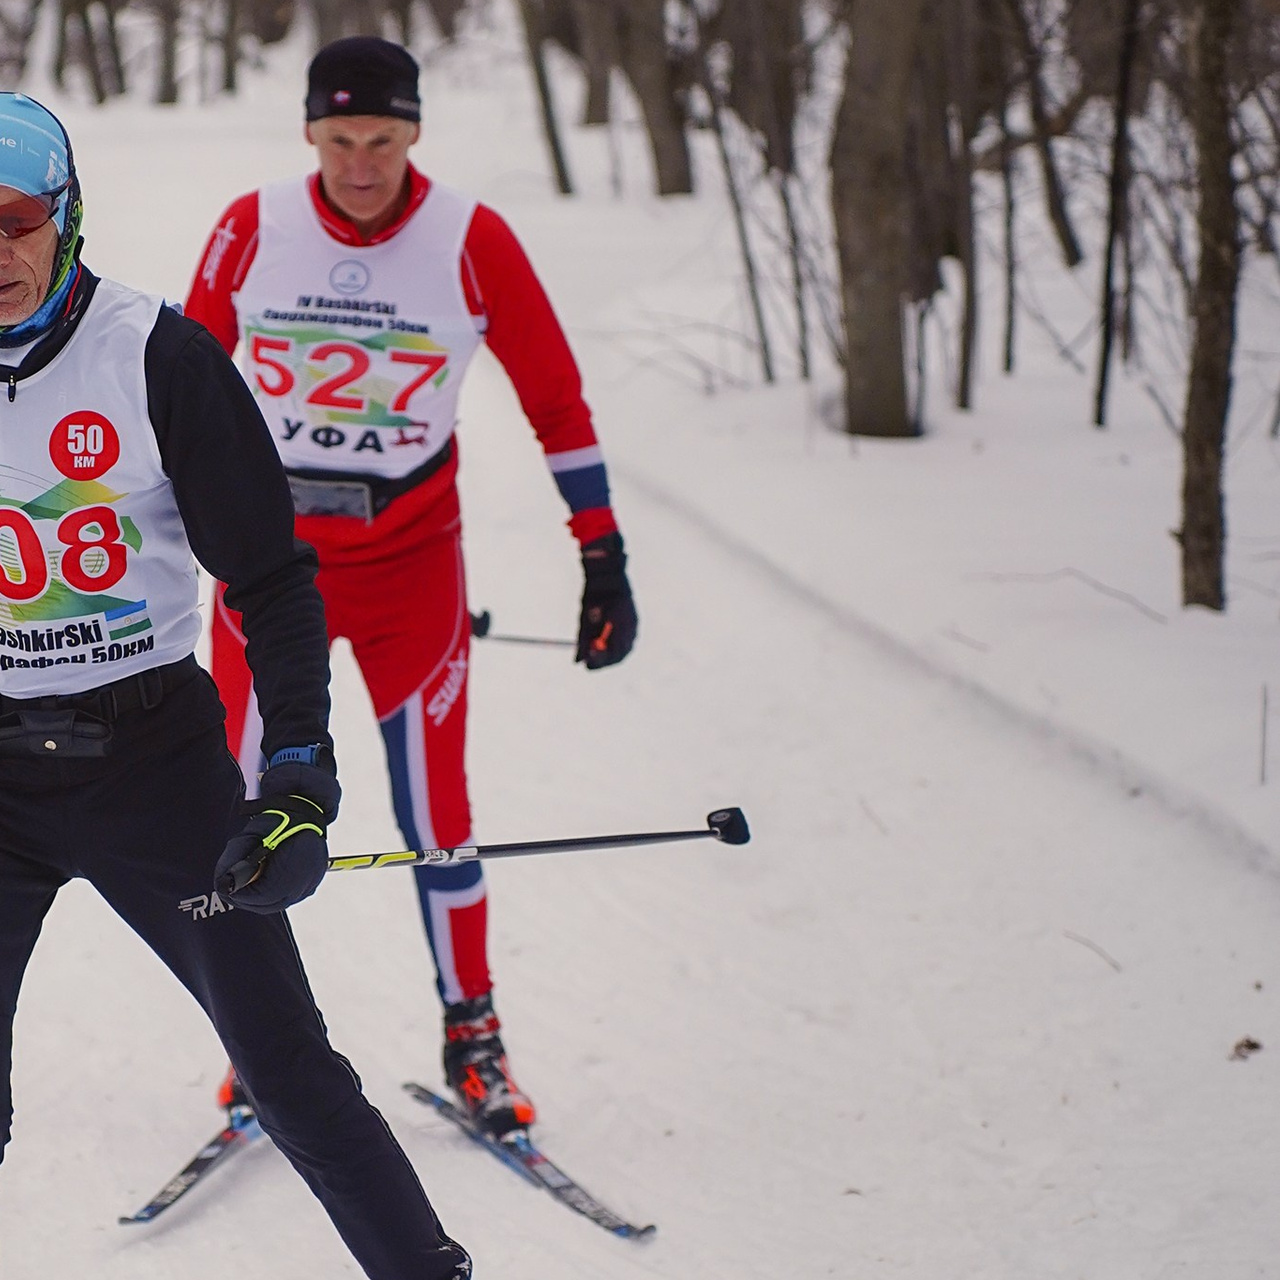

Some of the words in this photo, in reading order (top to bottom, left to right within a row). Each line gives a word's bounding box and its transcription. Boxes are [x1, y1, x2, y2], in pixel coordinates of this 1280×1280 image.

[251, 336, 448, 412] 527
[67, 424, 104, 455] 50
[282, 417, 384, 453] УФА
[178, 890, 234, 921] RA
